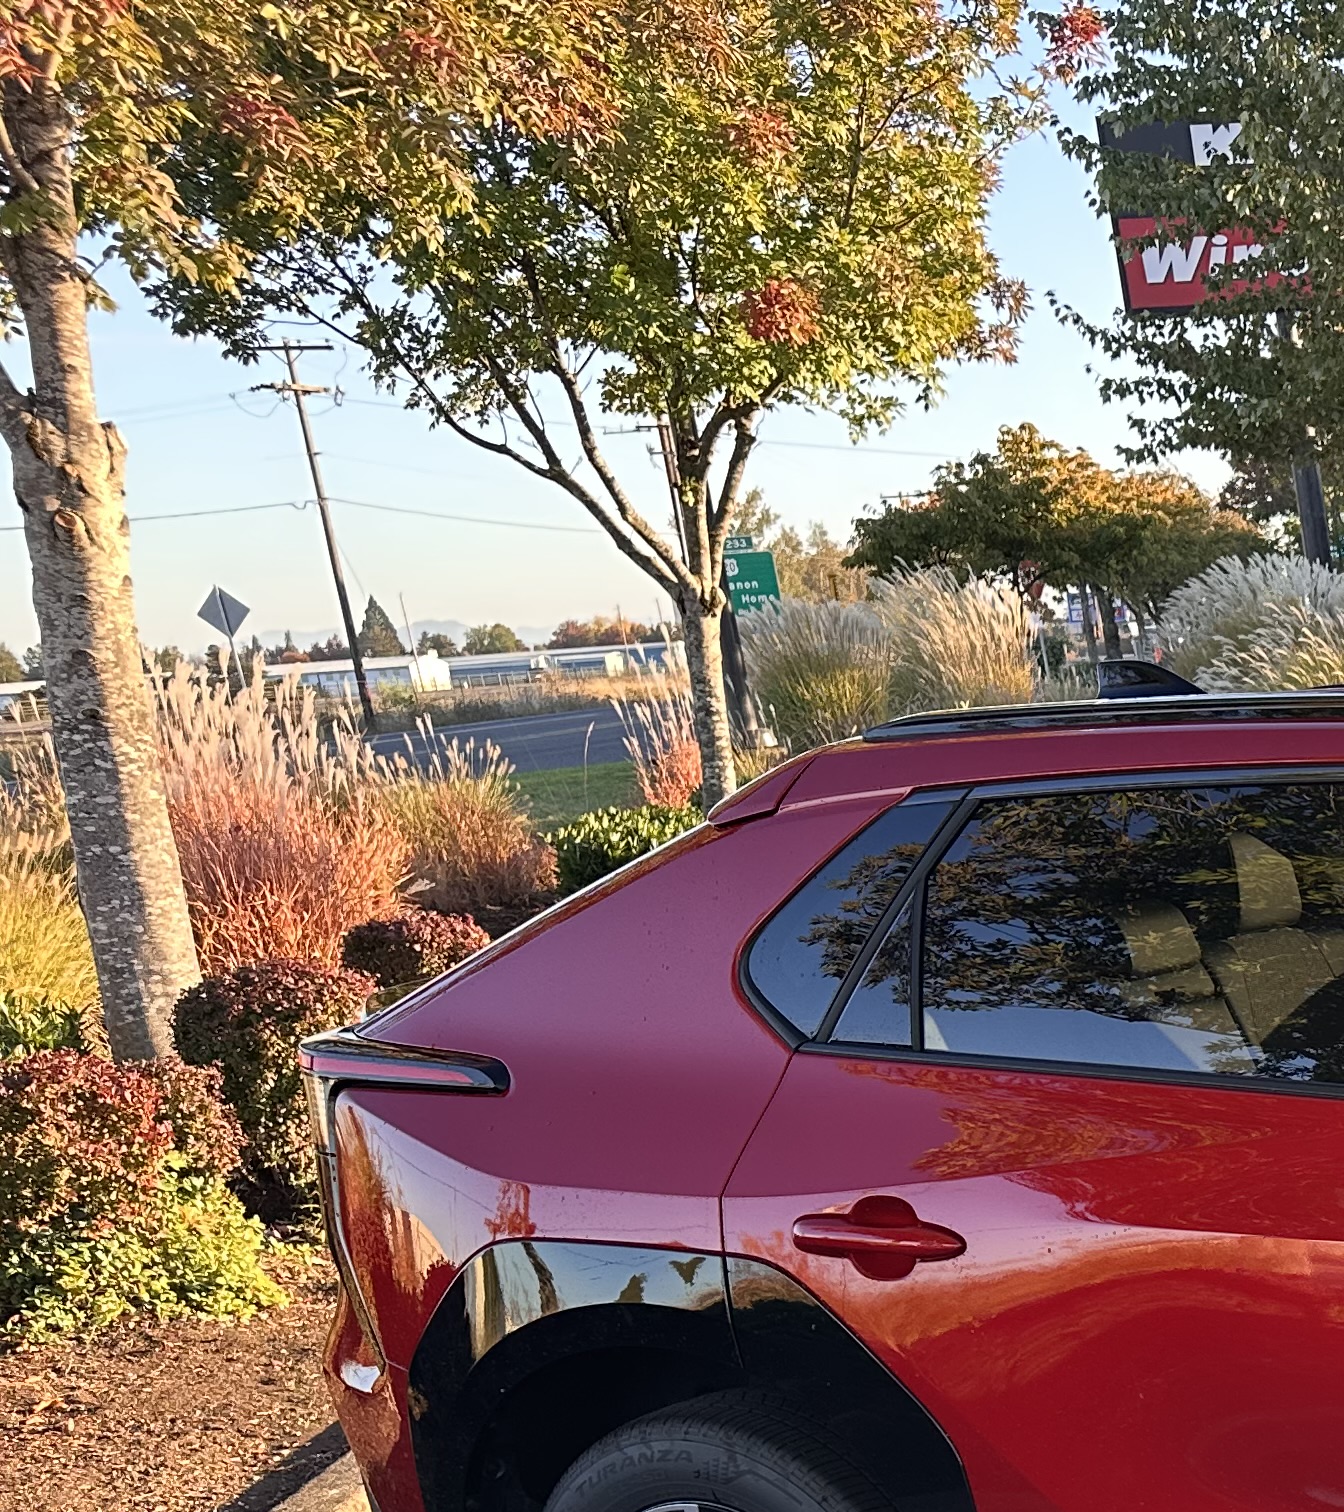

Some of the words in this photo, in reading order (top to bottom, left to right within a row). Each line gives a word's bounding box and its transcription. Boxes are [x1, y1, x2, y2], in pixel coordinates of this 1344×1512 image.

[726, 539, 747, 549] 233
[728, 580, 759, 590] anon
[573, 1449, 693, 1498] TURANZA
